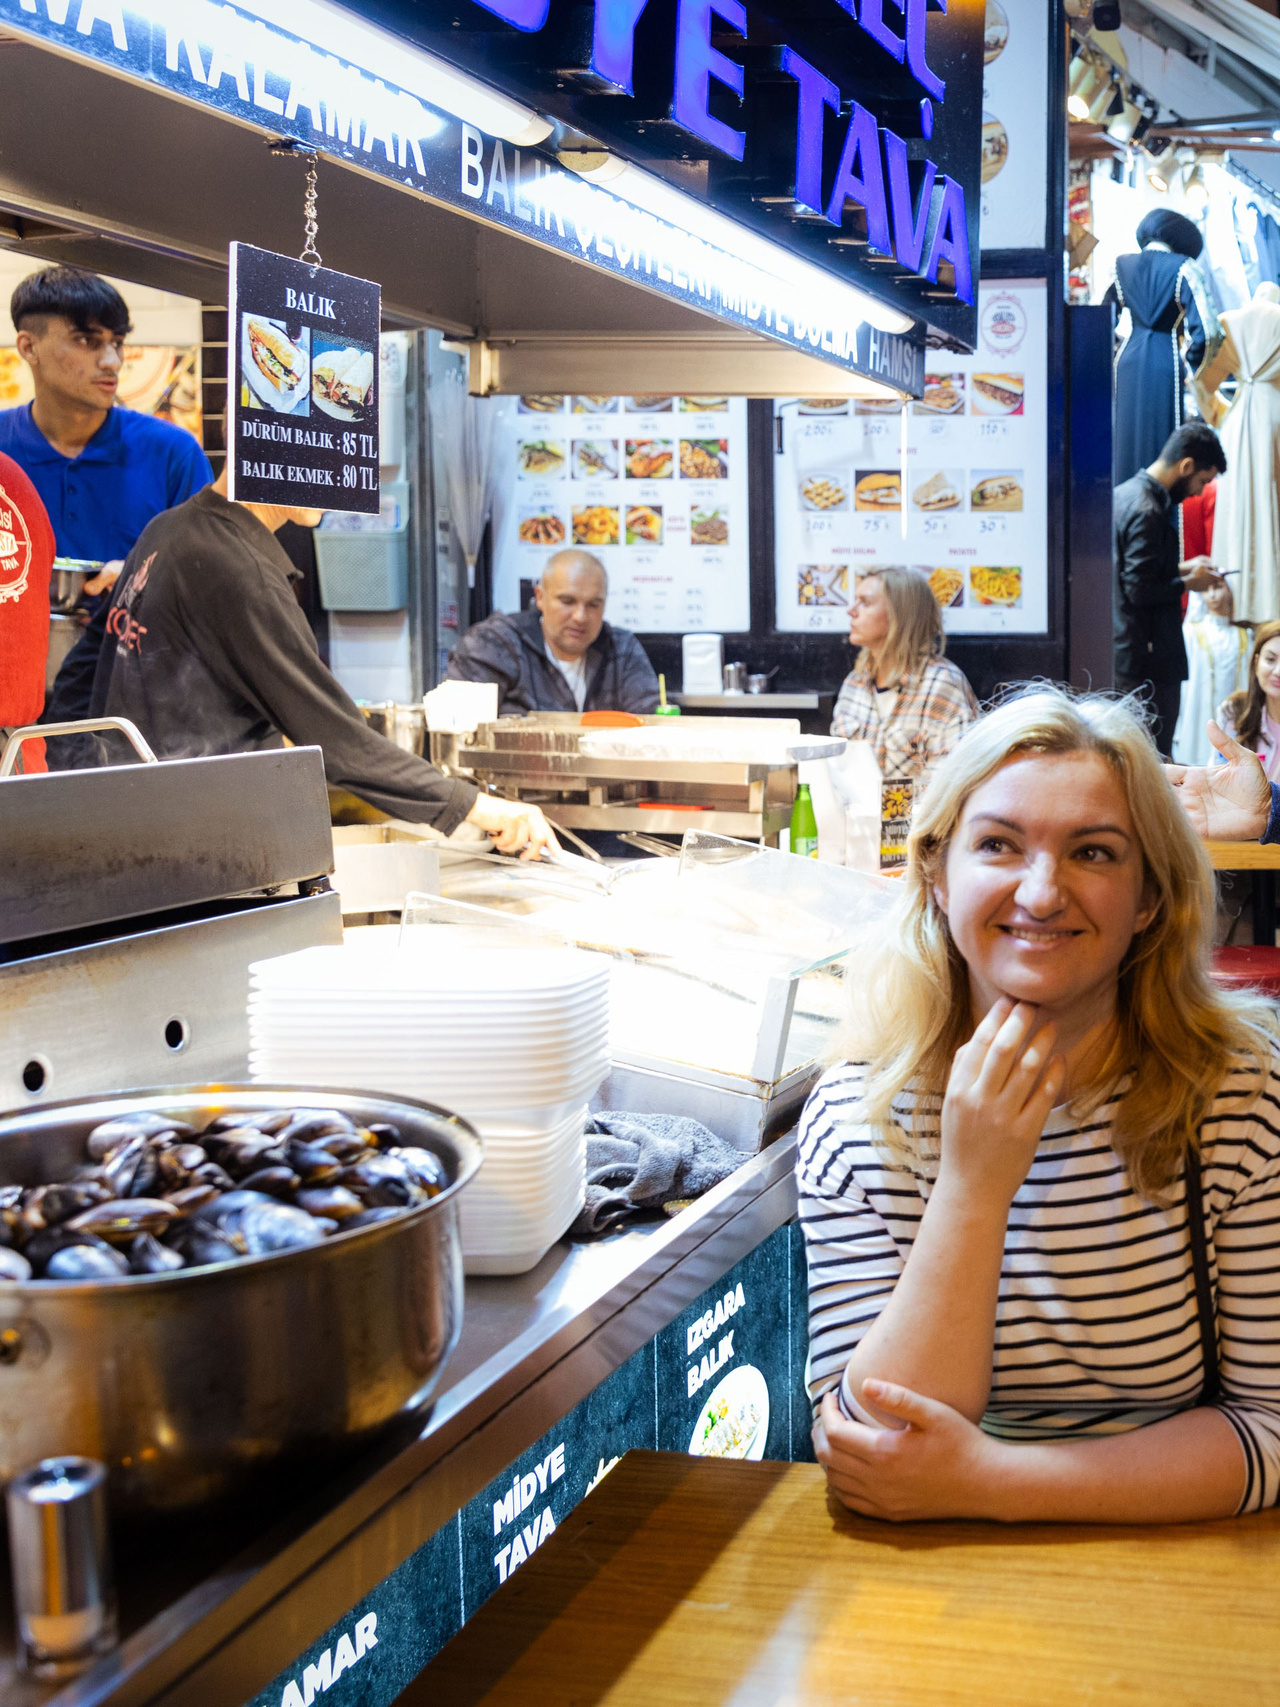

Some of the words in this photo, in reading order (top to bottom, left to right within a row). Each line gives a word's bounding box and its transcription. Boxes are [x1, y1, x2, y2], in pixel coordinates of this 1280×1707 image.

[780, 44, 975, 307] TAVA
[285, 287, 336, 320] BALIK
[242, 420, 292, 442] DÜRÜM
[294, 429, 334, 450] BALIK
[359, 434, 378, 459] TL
[242, 460, 286, 482] BALIK
[287, 466, 334, 487] EKMEK
[359, 466, 378, 491] TL
[687, 1282, 746, 1356] IZGARA
[687, 1329, 735, 1399] BALIK
[493, 1442, 565, 1537] MİDYE
[494, 1505, 556, 1585] TAVA
[280, 1611, 379, 1707] AMAR
